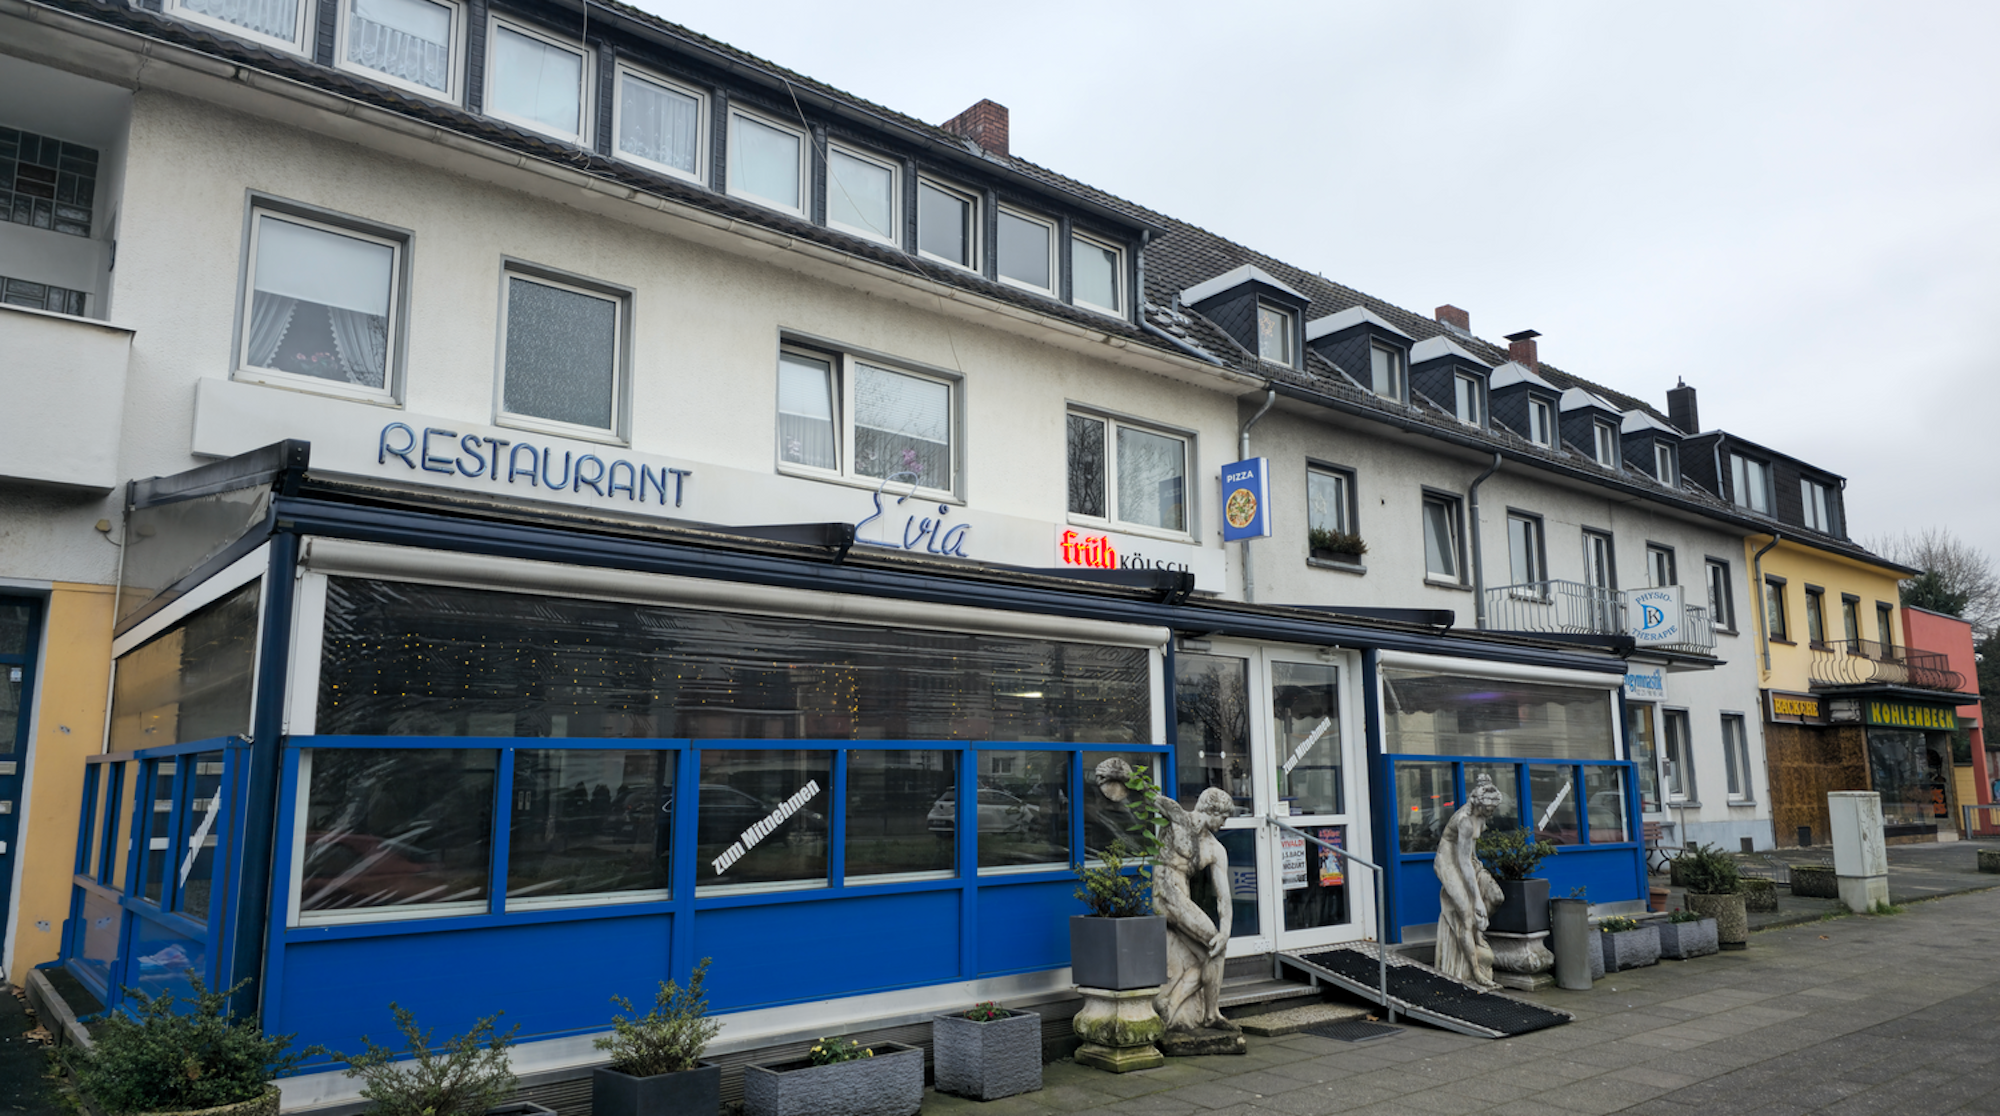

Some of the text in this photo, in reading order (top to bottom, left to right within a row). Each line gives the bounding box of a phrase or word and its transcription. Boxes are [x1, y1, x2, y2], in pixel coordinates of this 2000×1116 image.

[378, 421, 692, 508] RESTAURANT
[1226, 470, 1254, 483] PIZZA
[1060, 530, 1117, 570] früh
[1631, 625, 1678, 640] THERAPIE
[1282, 716, 1331, 776] zum Mitnehmen
[711, 779, 821, 876] zum Mitnehmen
